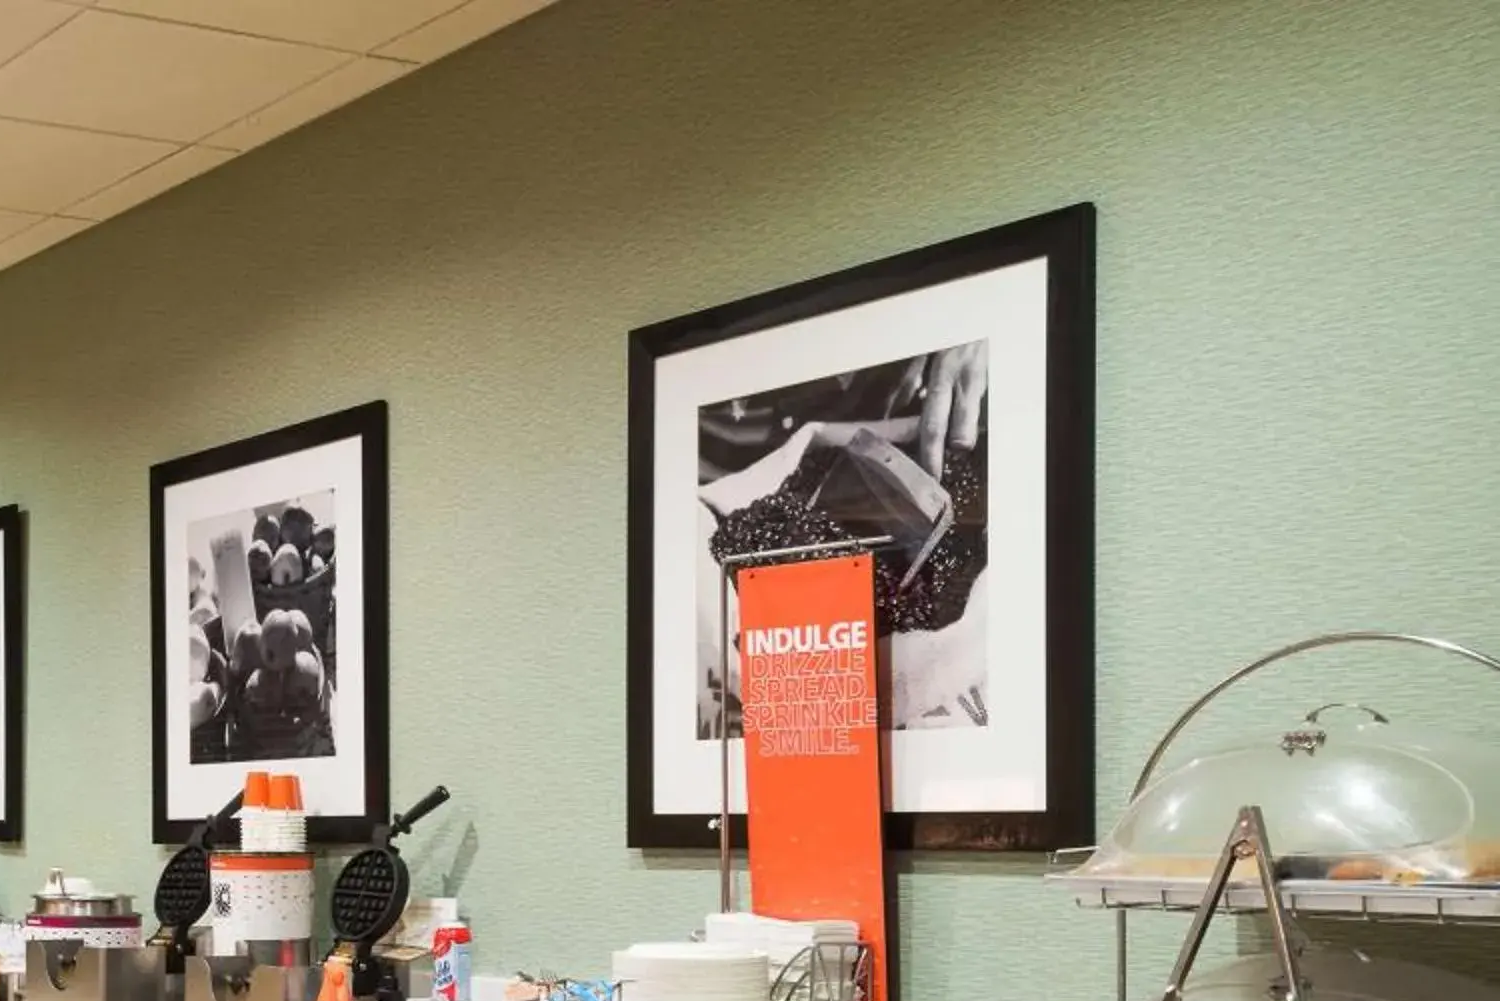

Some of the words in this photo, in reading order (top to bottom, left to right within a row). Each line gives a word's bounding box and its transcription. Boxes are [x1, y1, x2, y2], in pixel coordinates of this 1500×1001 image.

[746, 620, 868, 656] INDULGE
[750, 649, 866, 680] DRIZZLE
[749, 673, 867, 705] SPREAD
[742, 698, 878, 731] SPRINKLE
